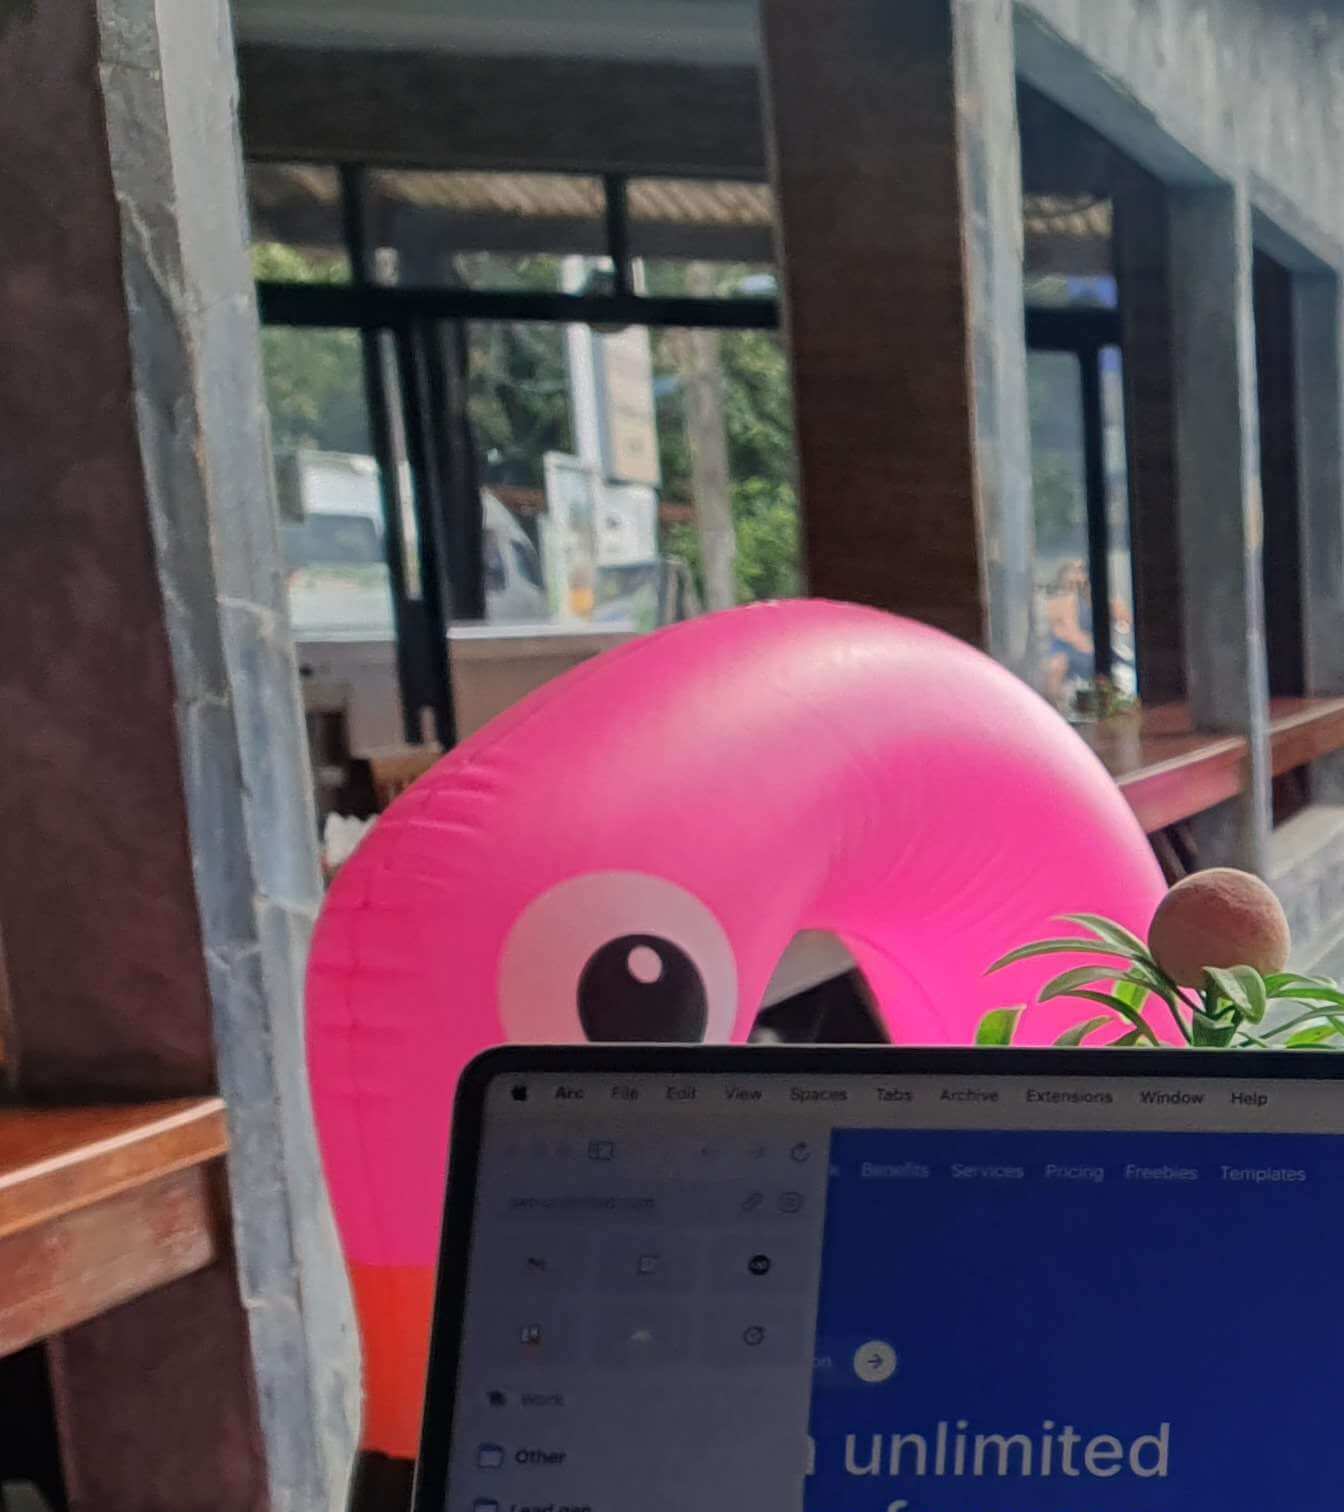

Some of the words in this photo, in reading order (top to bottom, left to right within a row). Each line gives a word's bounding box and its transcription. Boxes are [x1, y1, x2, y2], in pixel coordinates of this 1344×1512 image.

[555, 1085, 584, 1100] Arc
[666, 1085, 697, 1100] Edit
[725, 1086, 763, 1101] View
[790, 1086, 848, 1103] Spaces
[877, 1087, 912, 1102] Tabs
[940, 1088, 999, 1102] Archive
[1026, 1089, 1113, 1104] Extensions
[1140, 1090, 1204, 1105] Window
[1231, 1091, 1268, 1107] Help
[861, 1162, 929, 1178] Benefits
[951, 1163, 1024, 1179] Services
[1045, 1163, 1104, 1183] Pricing
[1125, 1164, 1199, 1180] Freebies
[1220, 1166, 1306, 1184] Templates
[515, 1449, 566, 1464] Other
[844, 1417, 1171, 1477] unlimited
